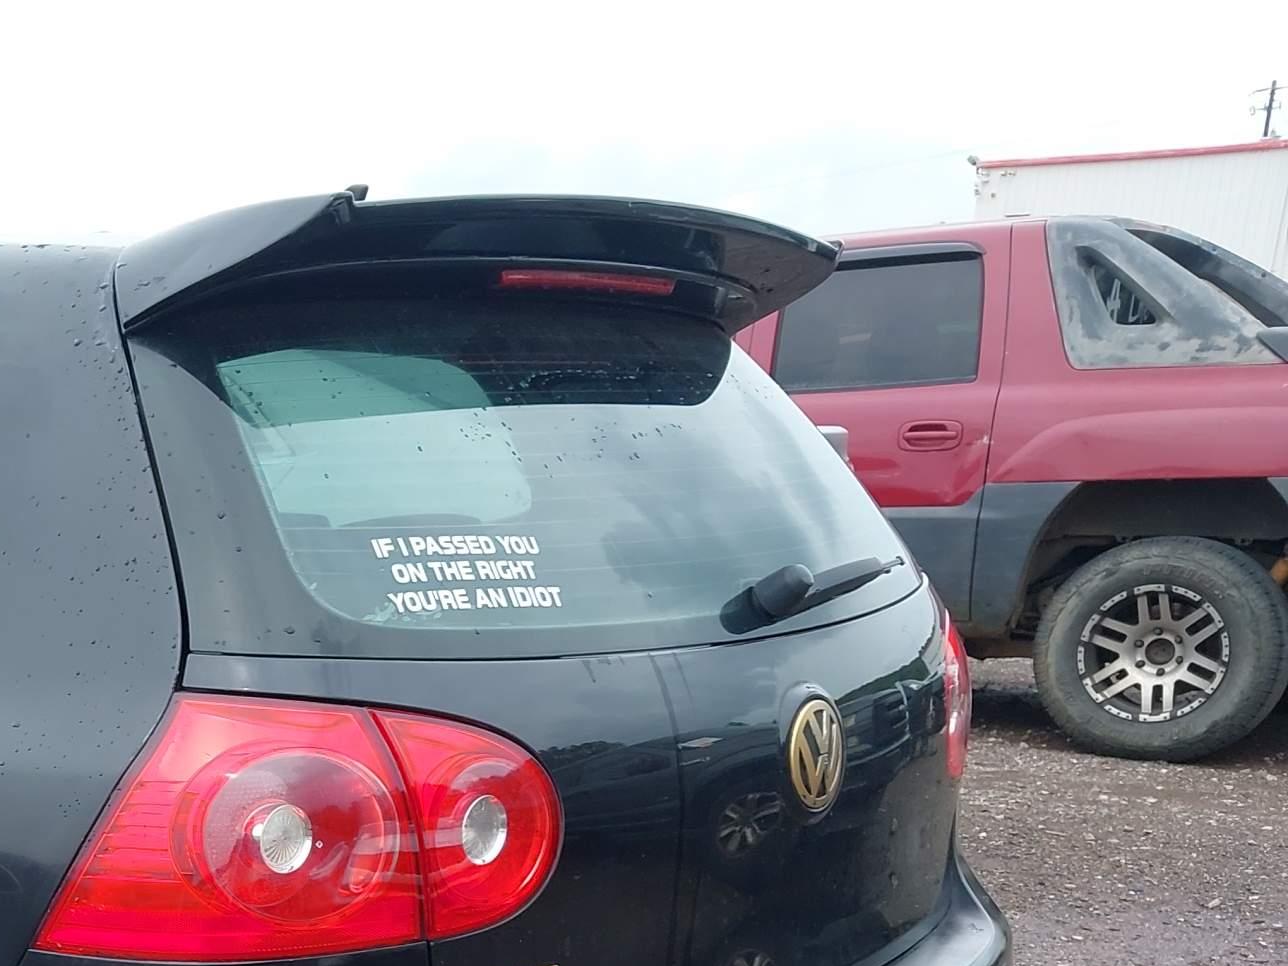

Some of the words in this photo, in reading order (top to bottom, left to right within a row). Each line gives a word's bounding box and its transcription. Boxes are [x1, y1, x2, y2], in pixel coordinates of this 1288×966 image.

[371, 537, 394, 558] IF
[396, 537, 409, 557] I
[409, 535, 496, 556] PASSED
[496, 535, 540, 555] YOU
[391, 562, 428, 584] ON
[427, 560, 476, 581] THE
[475, 560, 537, 580] RIGHT
[387, 588, 472, 613] YOU'RE
[475, 587, 509, 609] AN
[507, 586, 562, 608] IDIOT
